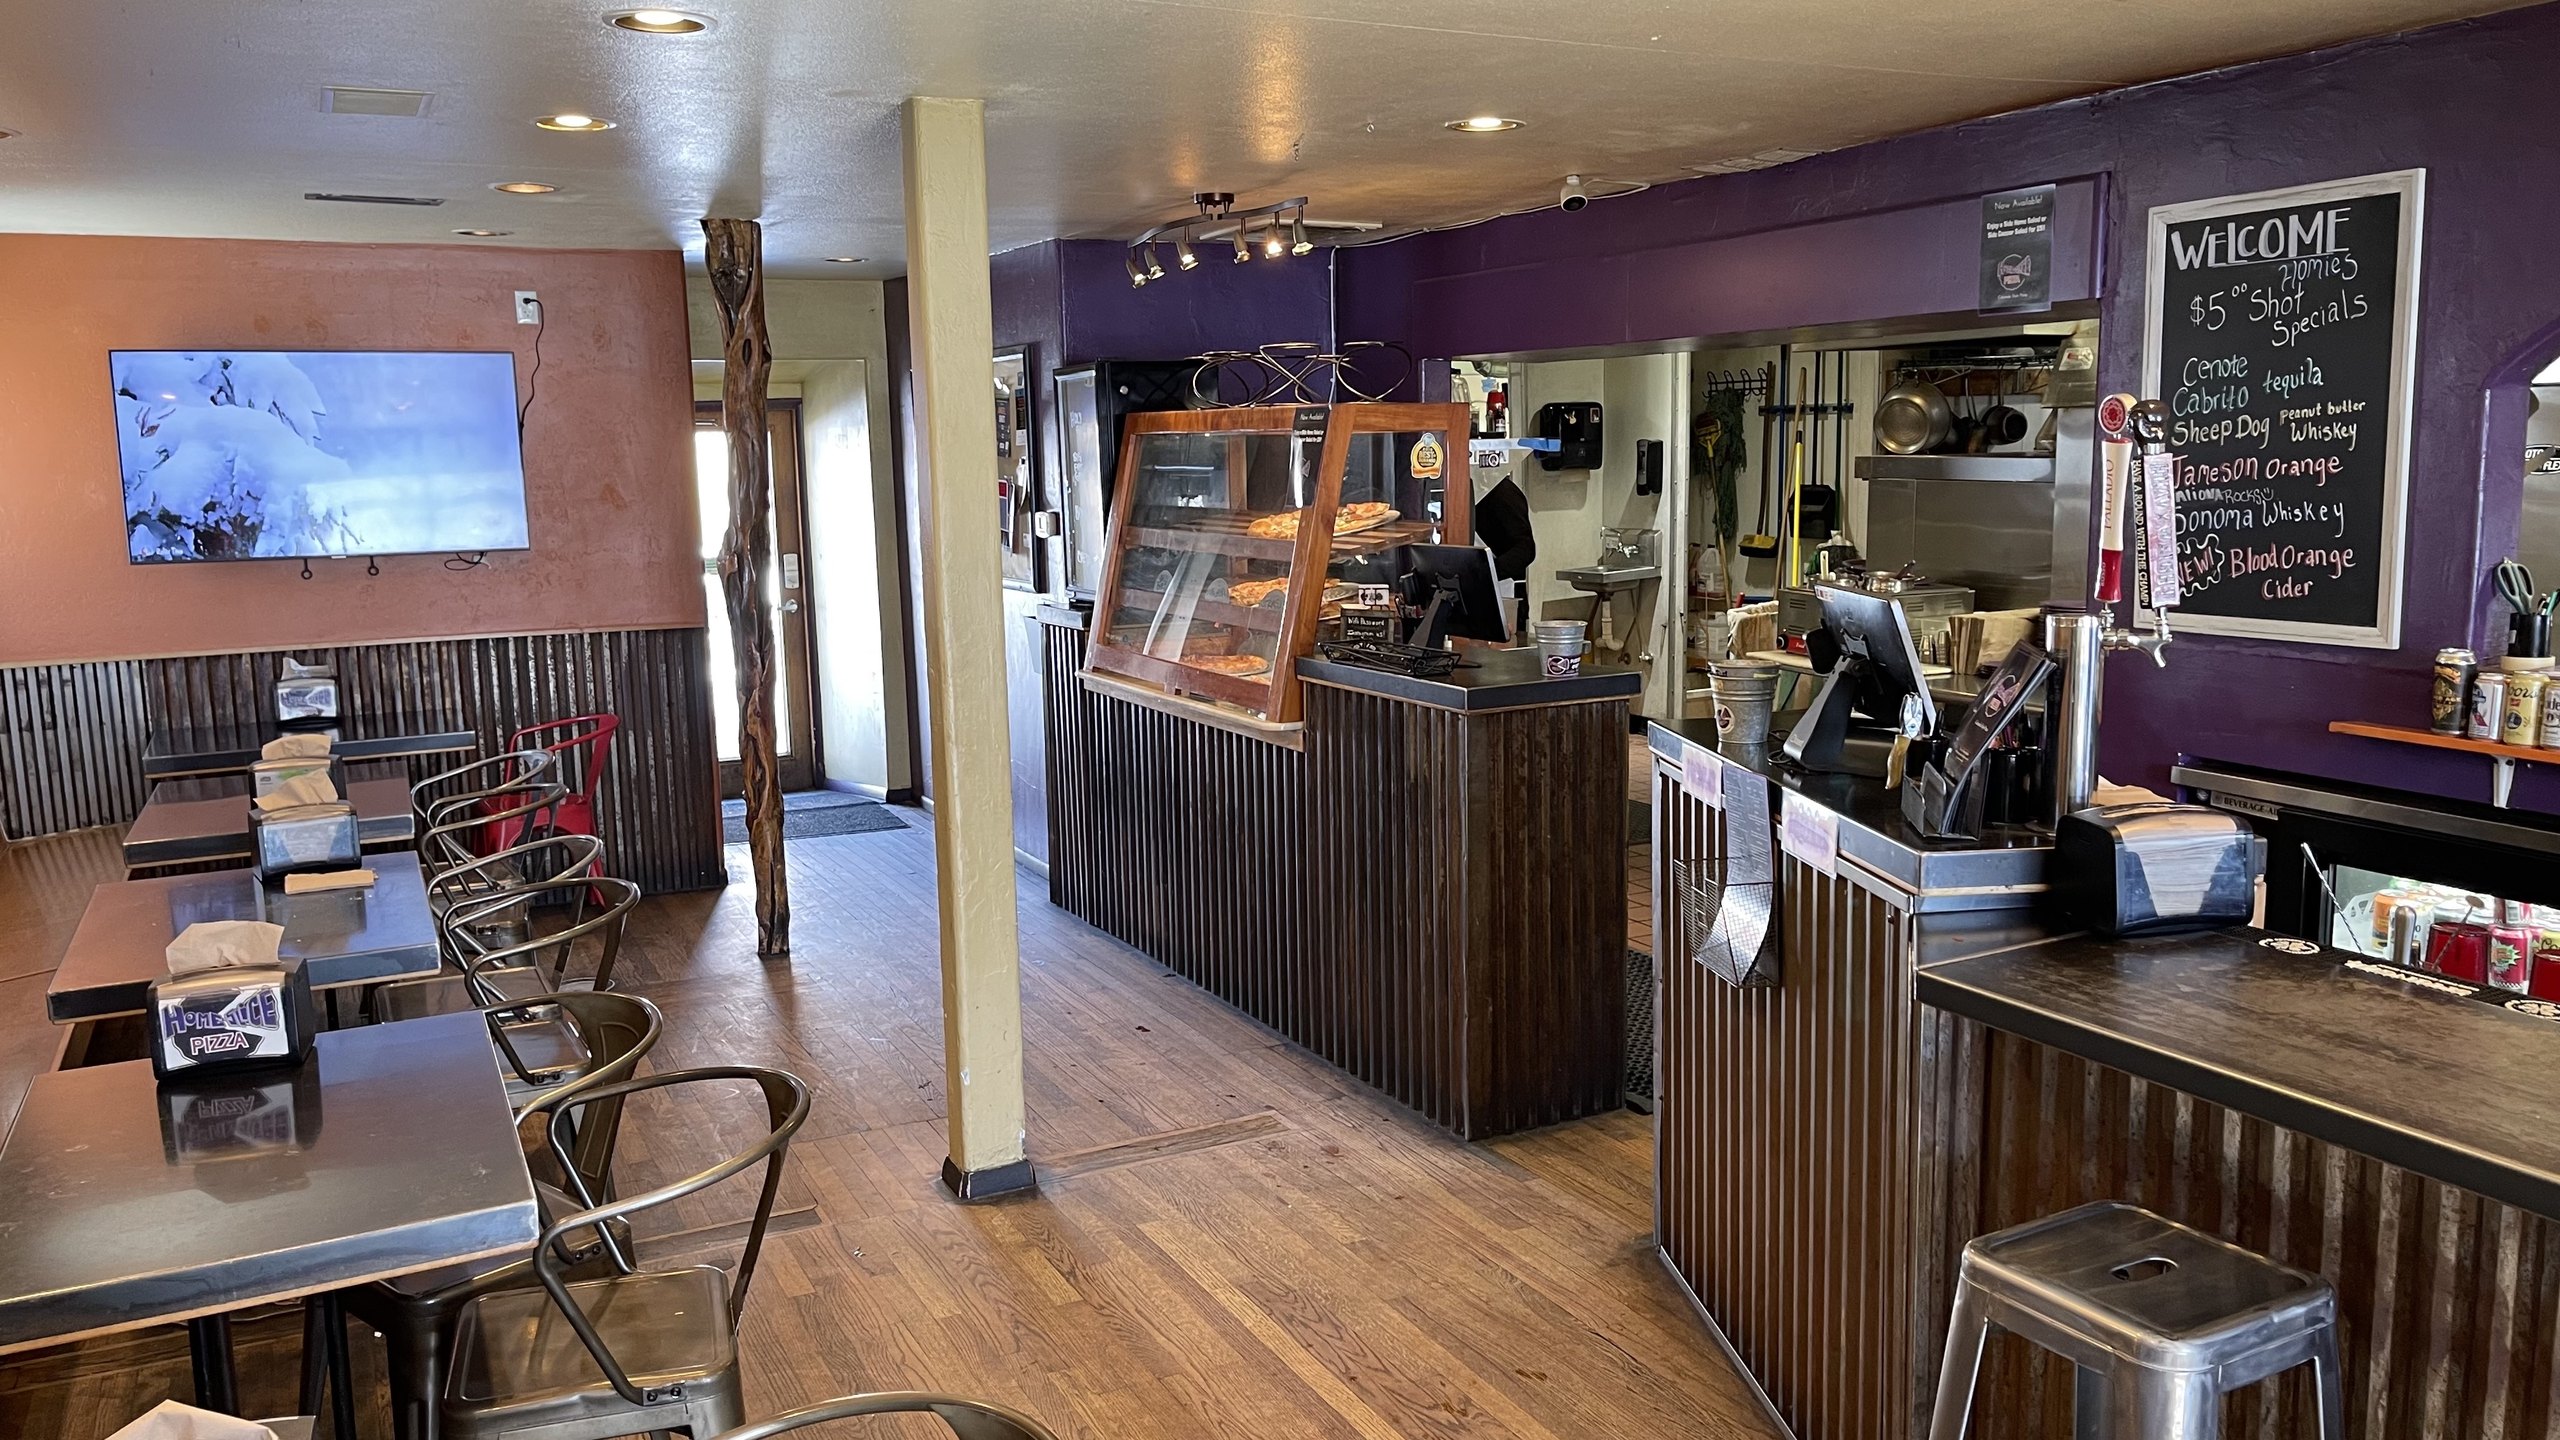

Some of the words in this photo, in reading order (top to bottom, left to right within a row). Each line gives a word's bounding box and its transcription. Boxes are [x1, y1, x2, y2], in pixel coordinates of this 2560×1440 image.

[1994, 201, 2010, 210] Now
[2171, 207, 2351, 270] WELCOME
[2279, 253, 2358, 291] Homies
[2249, 283, 2305, 322] Shot
[2271, 290, 2369, 347] Specials
[2183, 354, 2249, 387] Cenote
[2262, 356, 2325, 399] tequila
[2172, 385, 2250, 417] Cabrito
[2327, 399, 2367, 416] butter
[2104, 458, 2115, 530] PALLADIO
[2134, 494, 2144, 525] ROUND
[2175, 505, 2253, 535] Sonoma
[2136, 526, 2146, 550] WITH
[2138, 551, 2147, 570] THE
[2229, 542, 2278, 578] Blood
[2263, 576, 2314, 599] Cider
[190, 1032, 249, 1056] PIZZA
